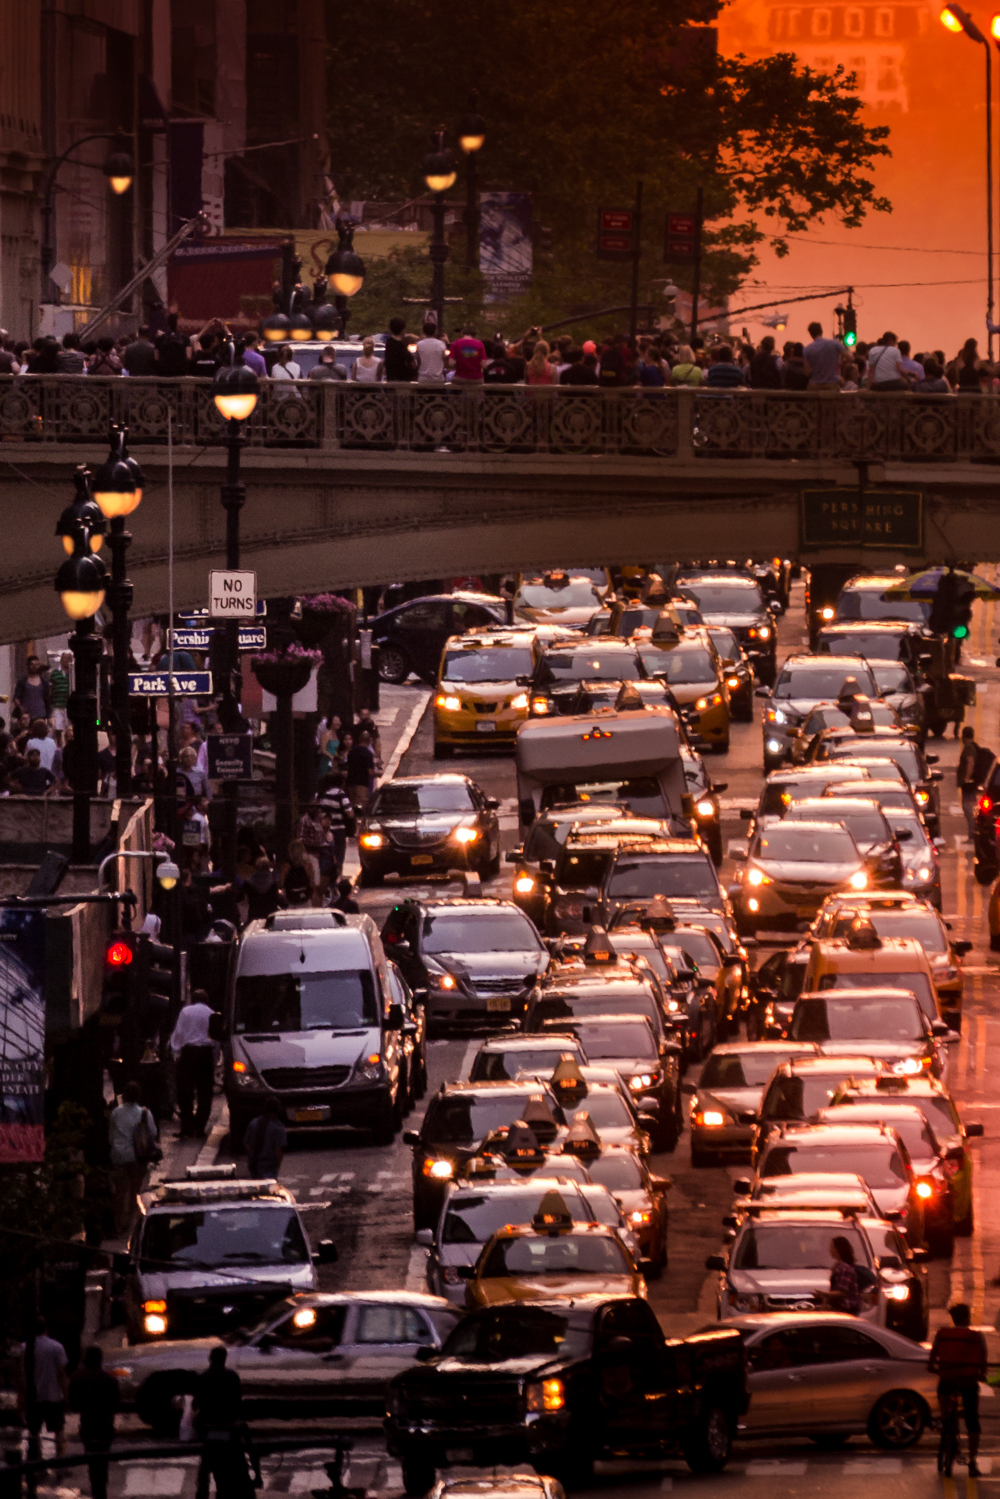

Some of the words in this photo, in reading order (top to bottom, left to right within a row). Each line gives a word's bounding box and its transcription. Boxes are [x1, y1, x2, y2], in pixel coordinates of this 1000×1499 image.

[822, 502, 904, 516] PERSHING
[223, 579, 242, 592] NO
[213, 597, 253, 610] TURNS
[133, 677, 167, 691] Park
[170, 677, 197, 691] Ave
